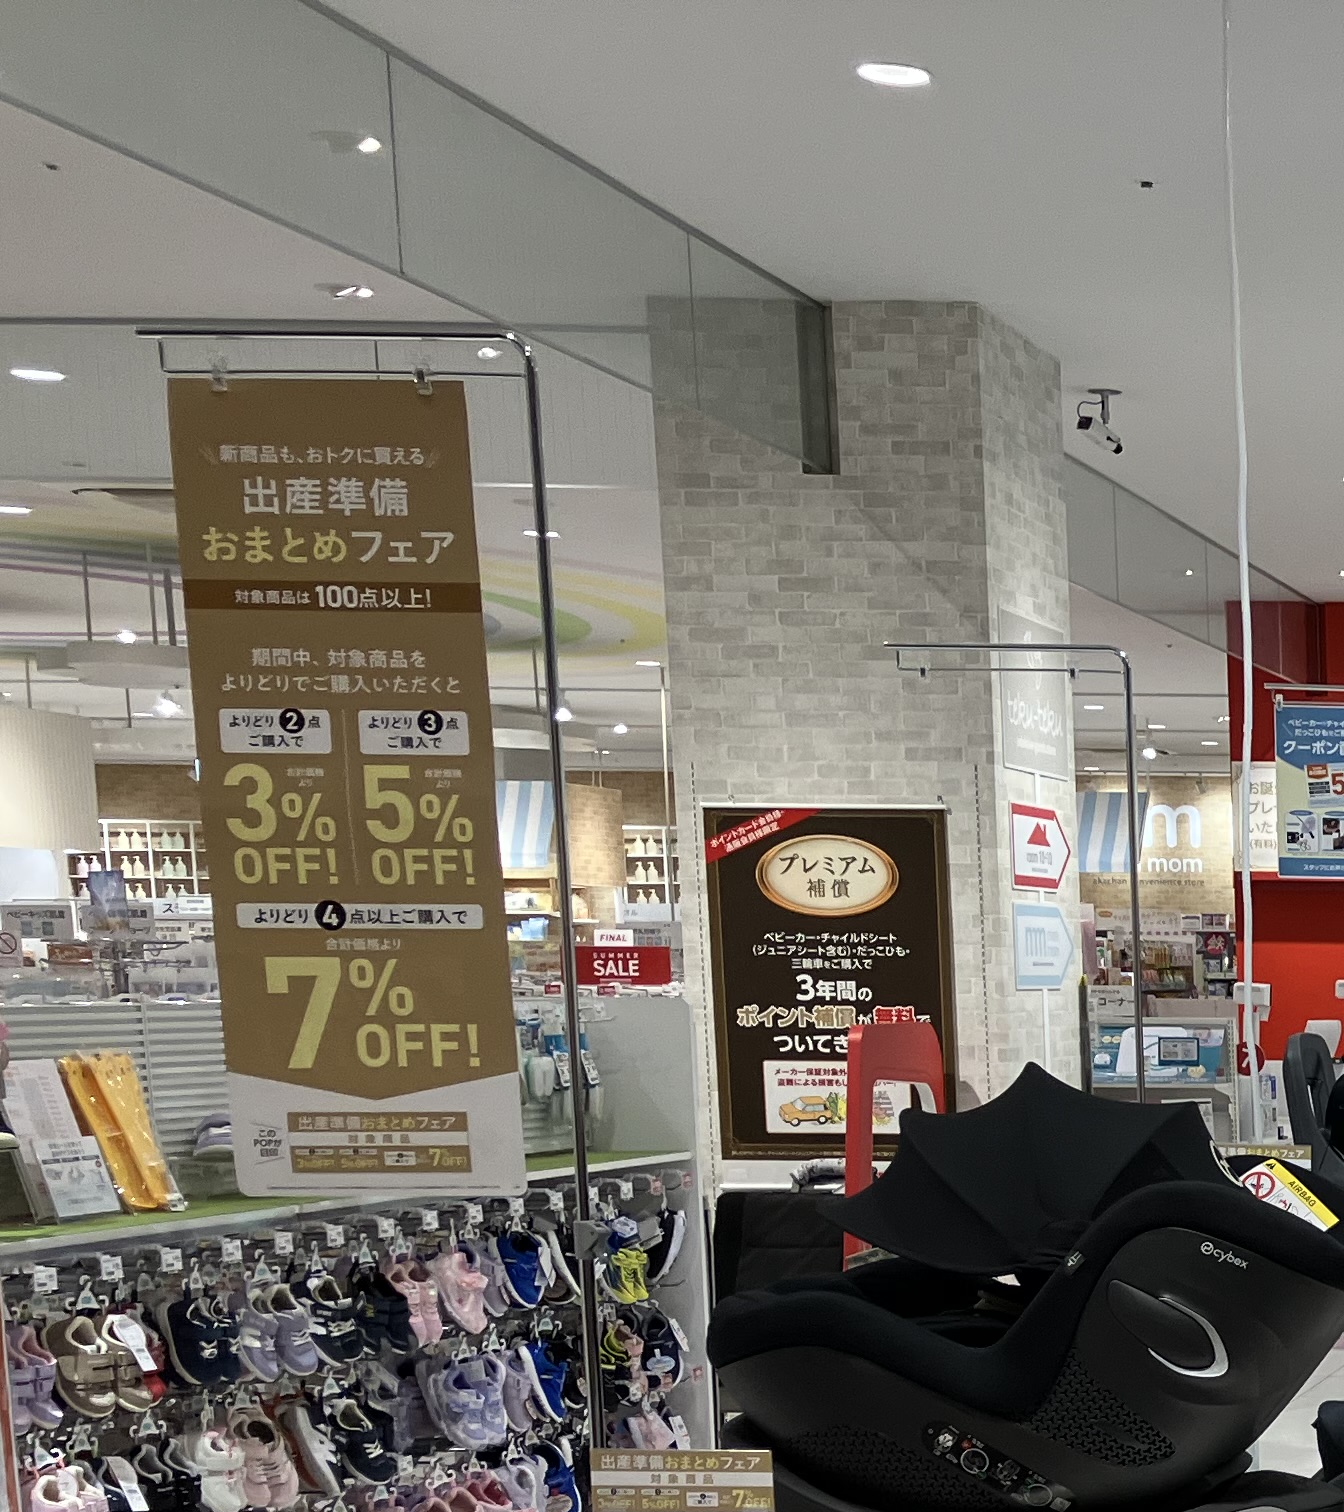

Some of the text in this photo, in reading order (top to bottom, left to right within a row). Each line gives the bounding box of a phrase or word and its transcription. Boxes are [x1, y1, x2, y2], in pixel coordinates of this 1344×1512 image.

[242, 475, 409, 517] 出産準備
[201, 525, 455, 564] おまとめフェア
[251, 647, 426, 669] 期間中、対象商品を
[220, 672, 461, 695] よりどりでご購入いただくと
[248, 734, 304, 748] ご購入で
[387, 735, 442, 750] ご購入で
[223, 763, 337, 842] 3%
[363, 764, 474, 843] 5%
[233, 846, 339, 885] OFF!
[371, 847, 476, 886] OFF!
[779, 853, 876, 876] プレミアム
[1147, 856, 1203, 873] mom
[806, 878, 851, 899] 補償
[253, 903, 468, 926] よりどり4点以上ご購入で
[599, 933, 628, 942] FINAL
[763, 931, 898, 944] ベビーカー・チャイルドシート
[593, 959, 640, 976] SALE
[795, 973, 873, 1002] 3年間の
[263, 956, 414, 1069] 7%
[355, 1023, 481, 1067] OFF!
[1286, 1180, 1317, 1207] AIRBAG
[1213, 1248, 1249, 1270] cybex
[601, 1454, 761, 1471] 出産準備おまとめフェア
